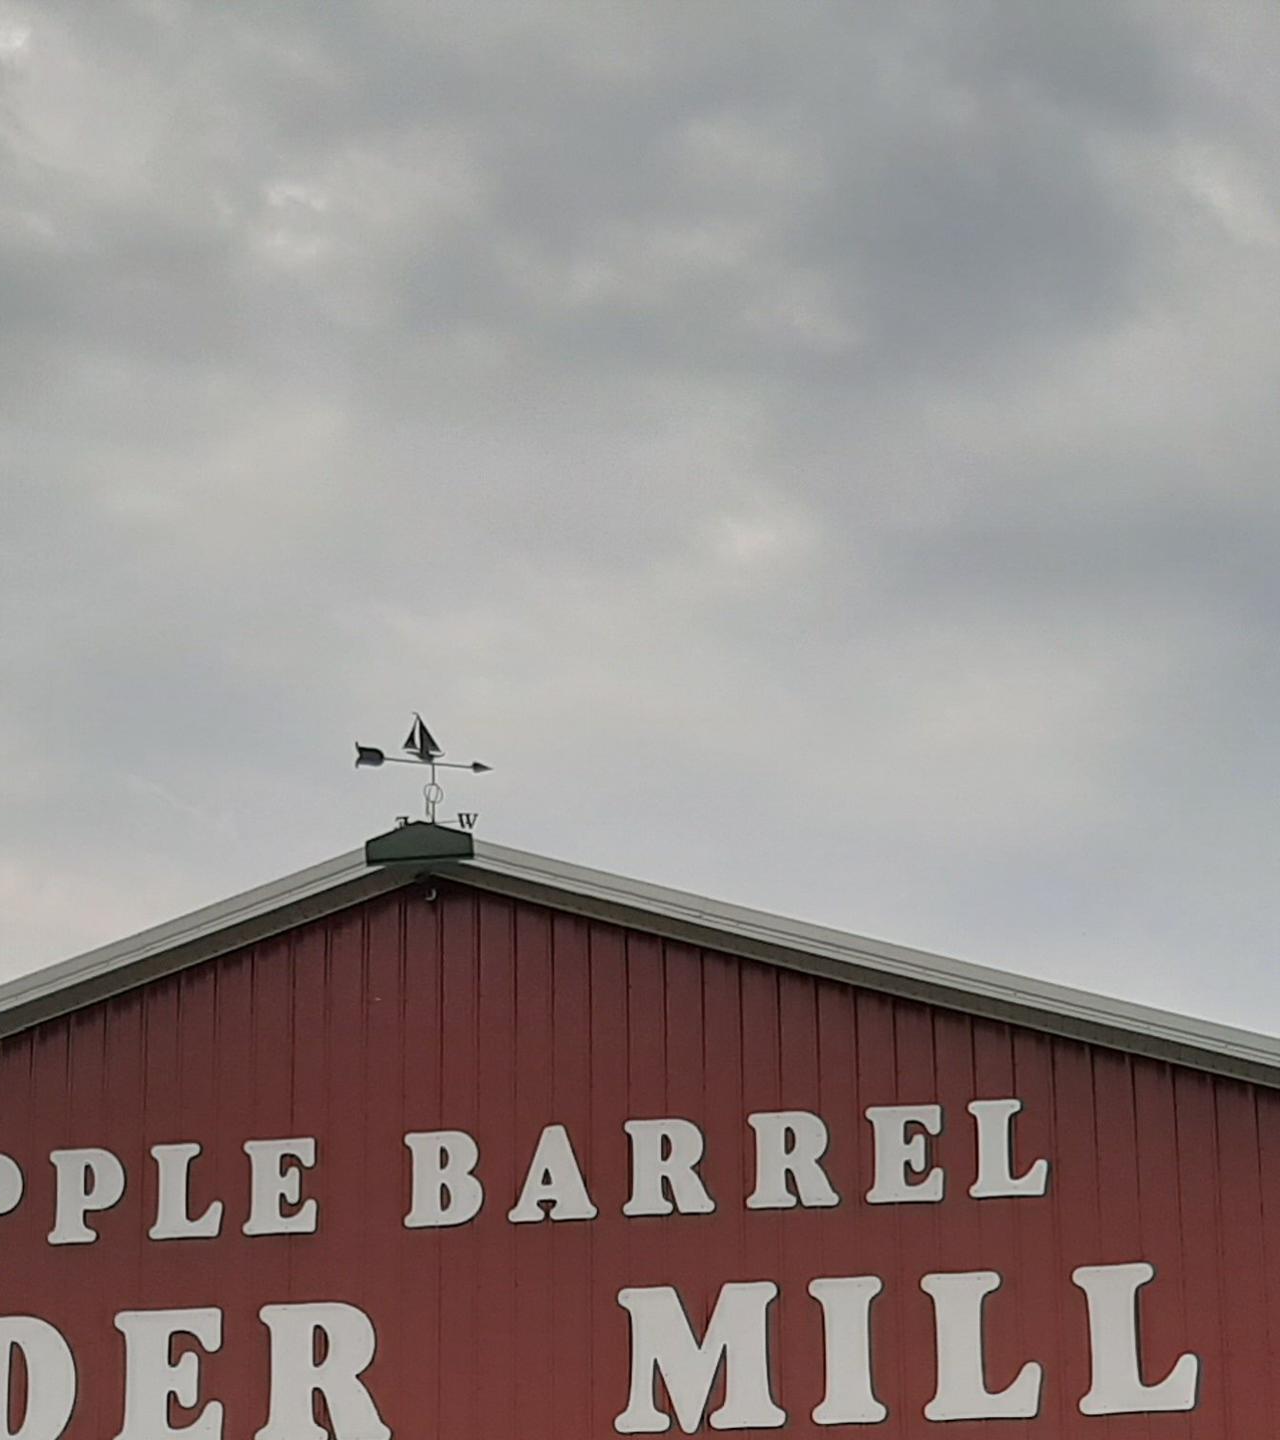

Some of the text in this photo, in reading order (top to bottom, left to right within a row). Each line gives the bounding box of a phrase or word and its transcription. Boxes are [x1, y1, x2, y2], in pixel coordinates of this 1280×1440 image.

[457, 812, 479, 830] W
[403, 1098, 1049, 1228] BARREL
[613, 1262, 1200, 1435] MILL
